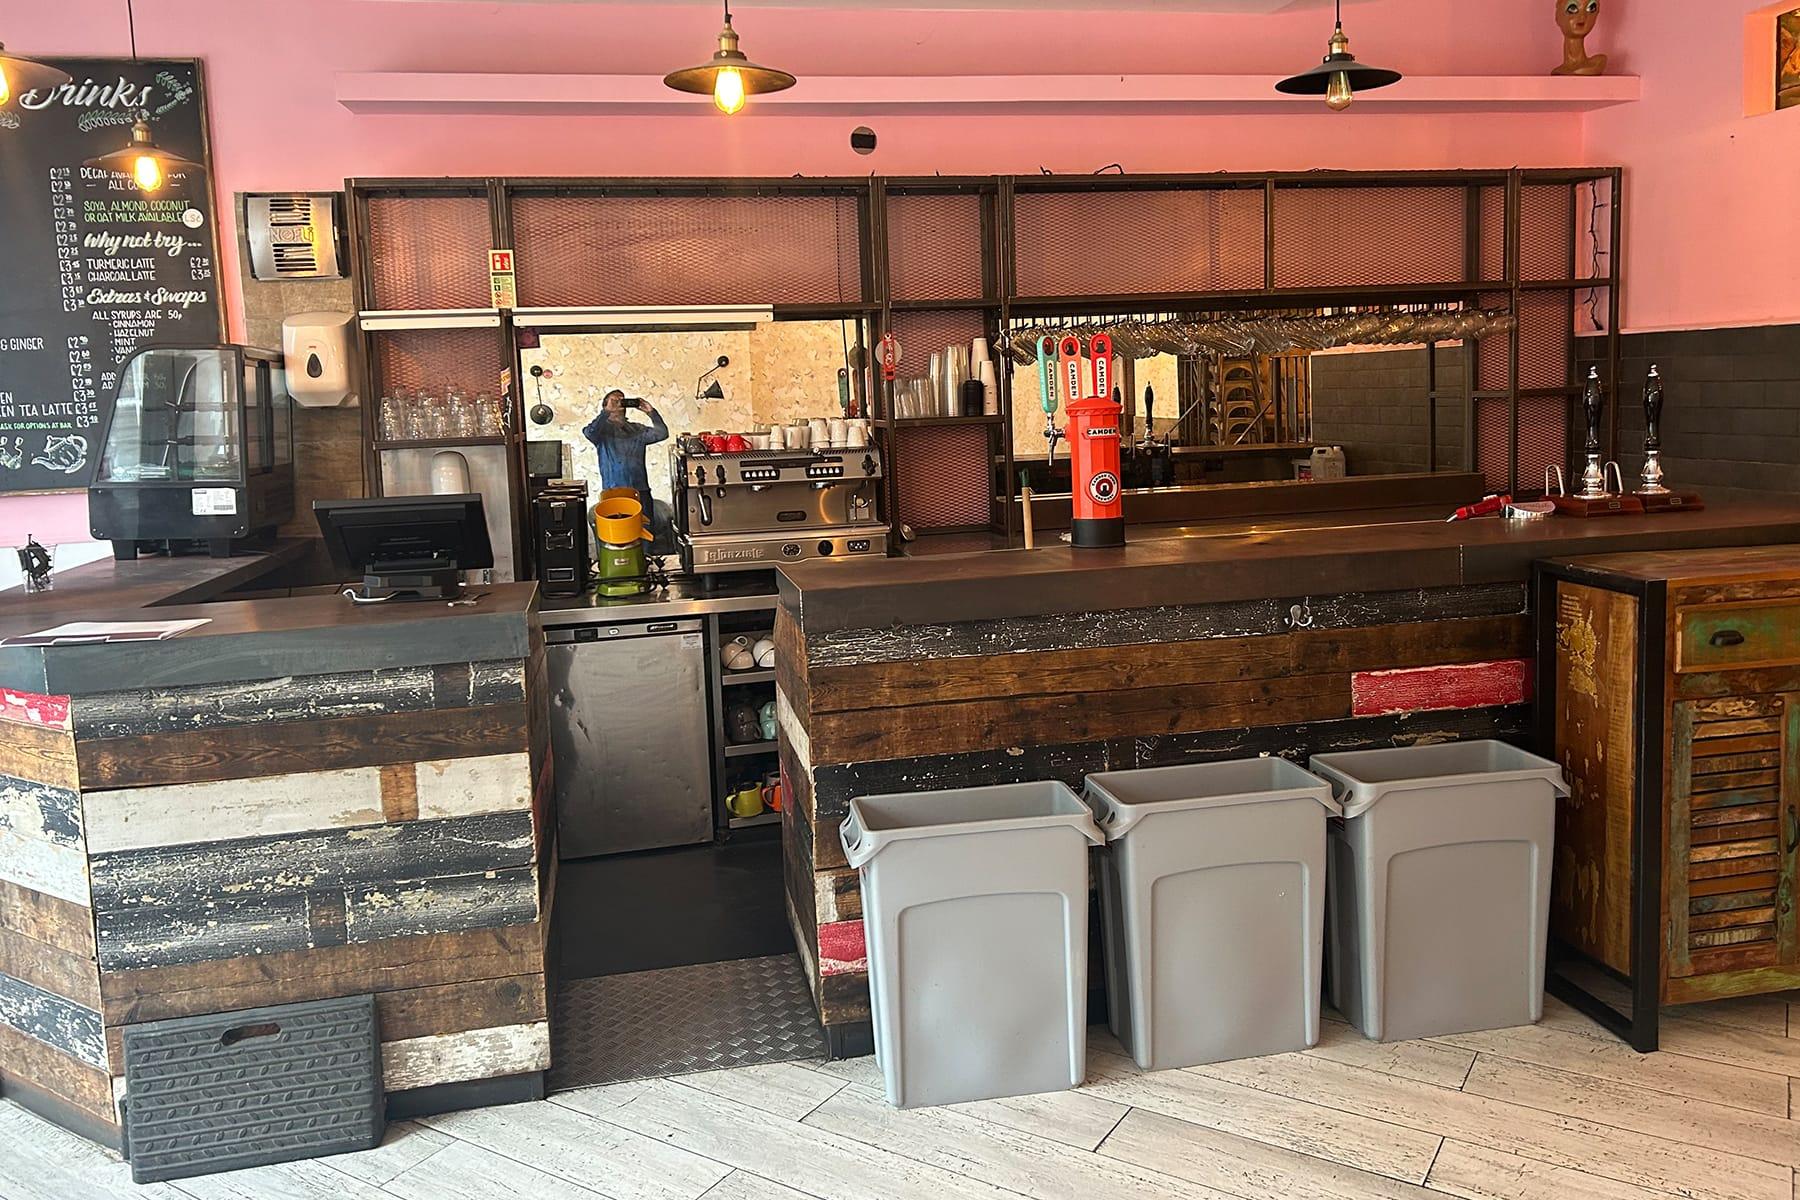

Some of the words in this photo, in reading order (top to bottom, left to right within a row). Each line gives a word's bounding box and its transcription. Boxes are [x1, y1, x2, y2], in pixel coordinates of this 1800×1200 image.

[108, 180, 125, 191] ALL
[151, 200, 190, 211] COCONUT
[84, 212, 97, 223] OR
[97, 212, 114, 222] OAT
[115, 212, 138, 223] MILK
[138, 211, 183, 222] AVAILABLE
[84, 231, 121, 256] Why
[122, 232, 152, 248] not
[86, 258, 130, 270] TURMERIC
[130, 257, 156, 269] LATTE
[87, 271, 132, 282] CHARCOAL
[132, 270, 156, 281] LATTE
[86, 287, 142, 305] Extras
[151, 287, 208, 309] Swaps
[92, 311, 110, 320] ALL
[111, 310, 142, 320] SYRUPS
[144, 310, 162, 319] ARE
[112, 319, 156, 328] CINNAMON
[113, 329, 155, 337] HAZELNUT
[10, 337, 44, 350] GINGER
[114, 338, 136, 346] MINT
[1069, 363, 1077, 397] CAMDEN
[19, 404, 39, 417] TEA
[41, 402, 73, 416] LATTE
[13, 422, 25, 430] FOR
[26, 422, 50, 430] OPTIONS
[1086, 428, 1117, 436] CAMDEN
